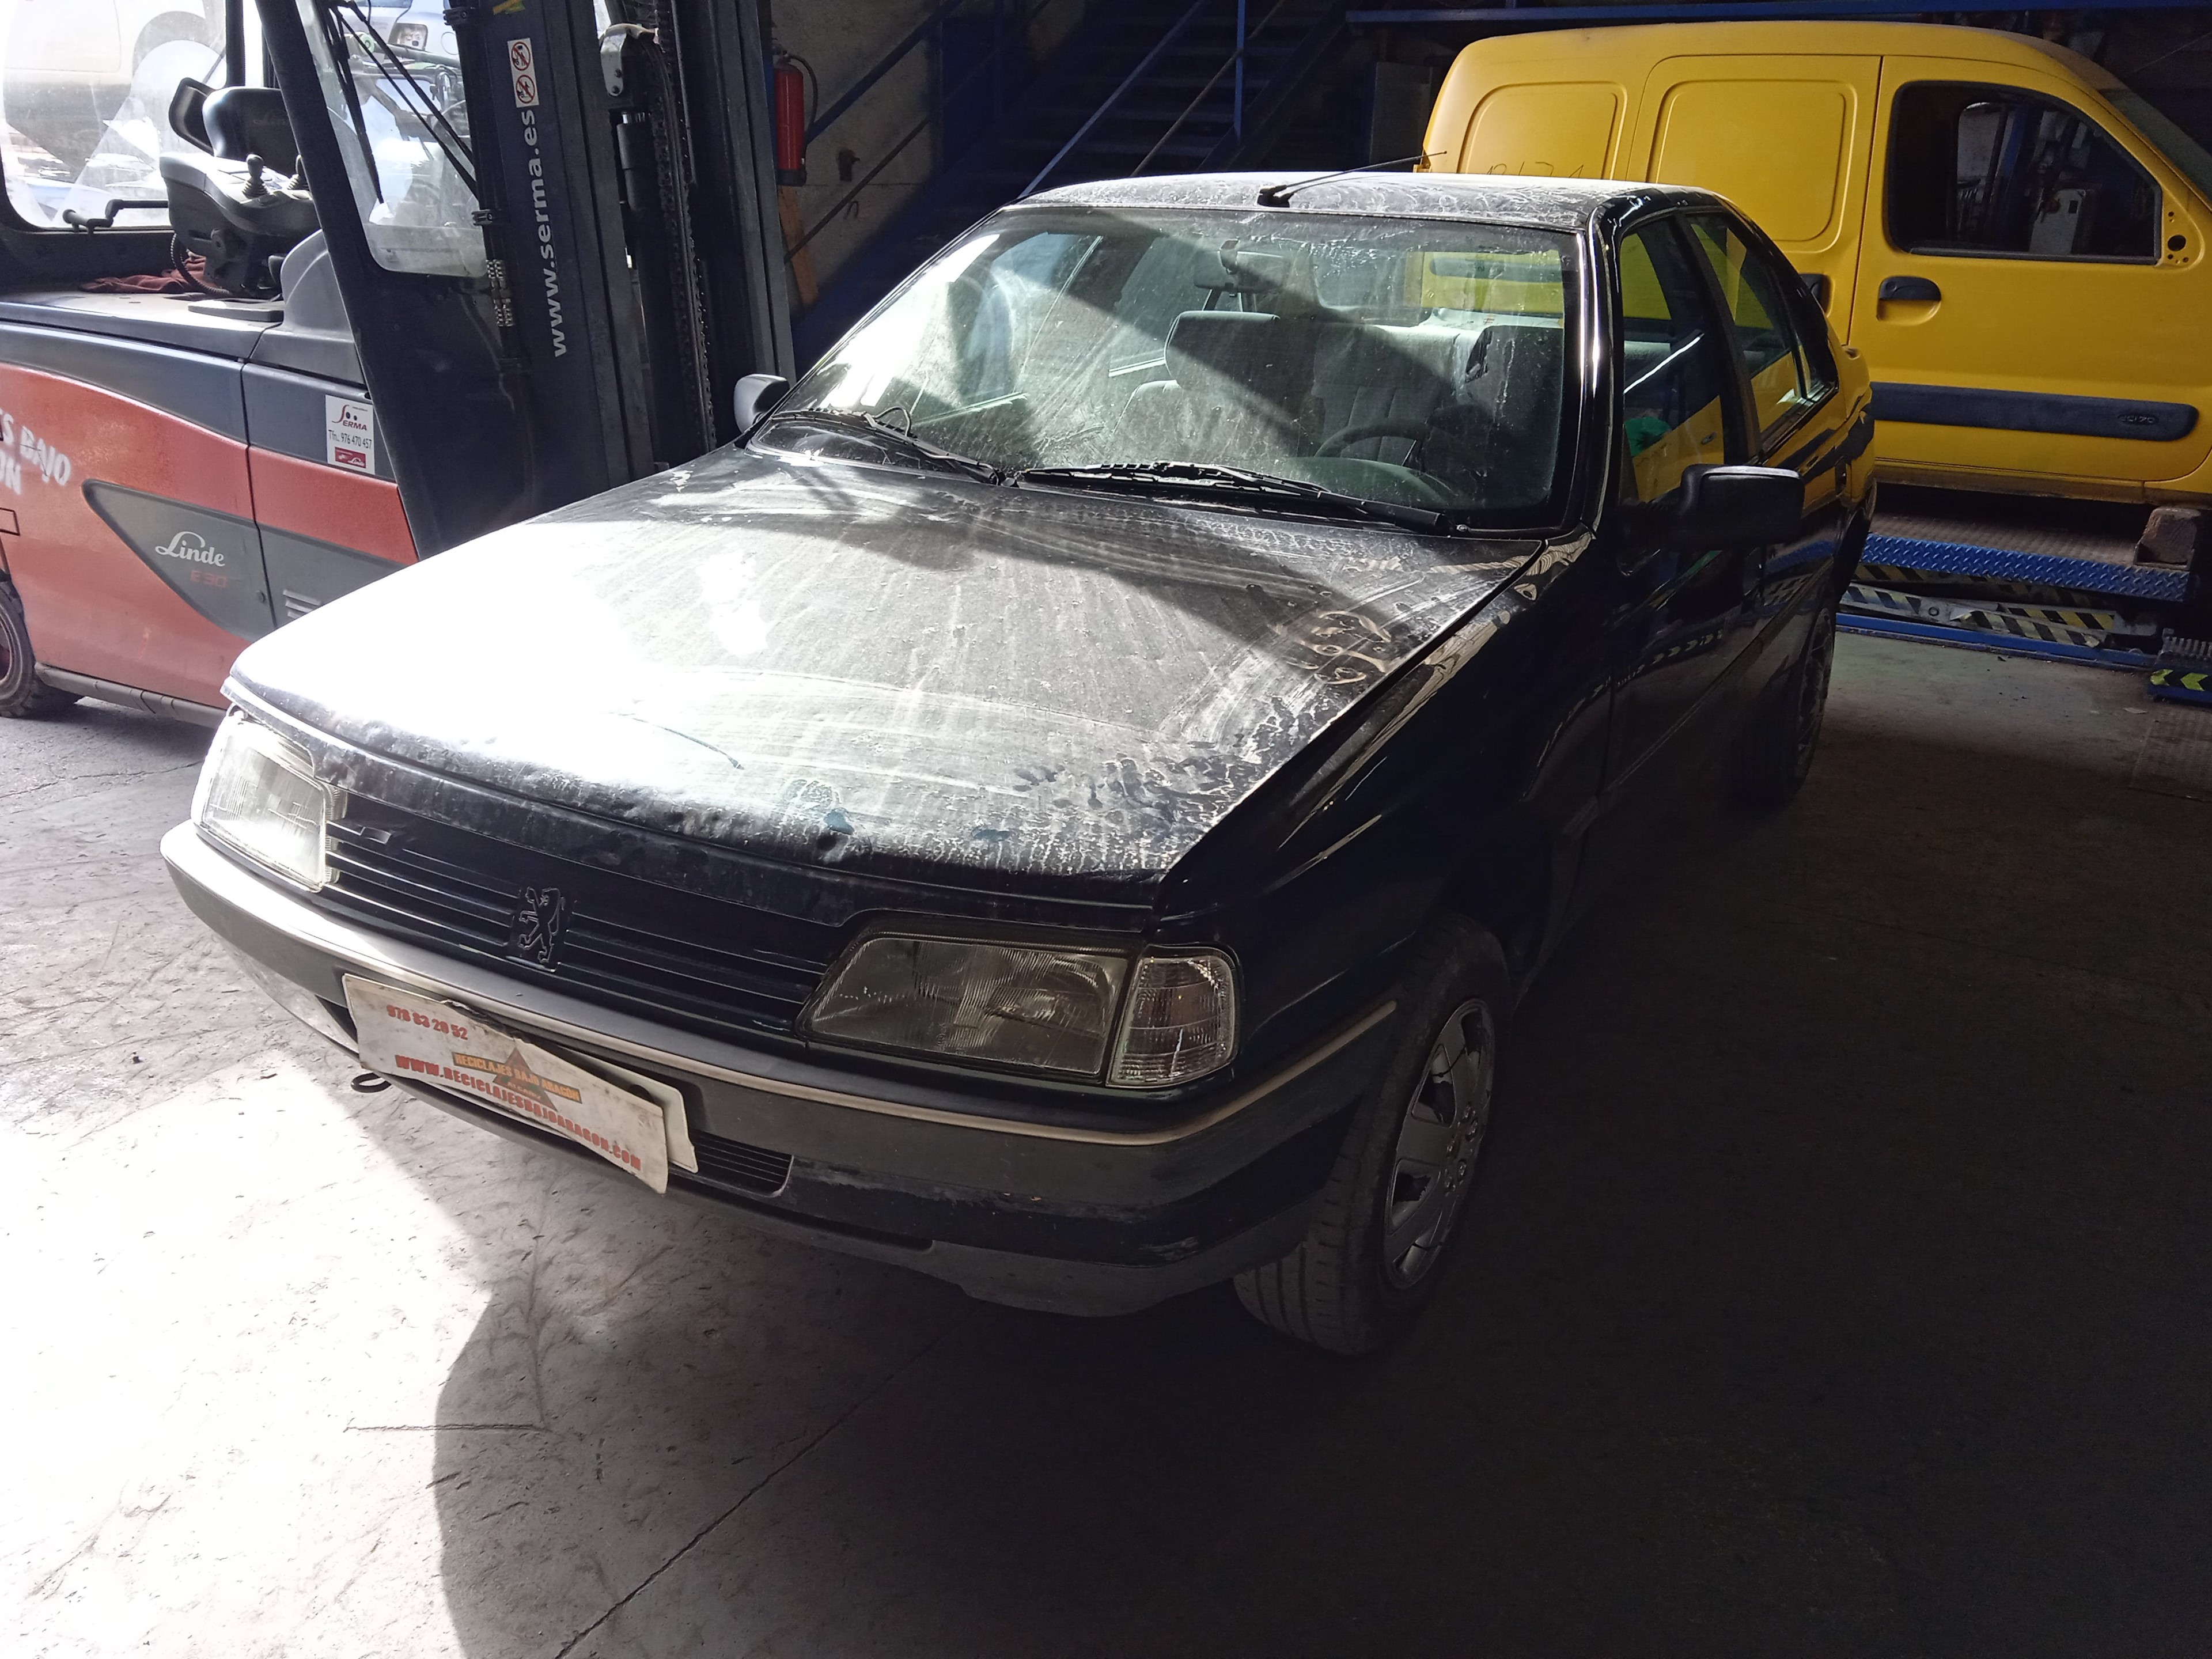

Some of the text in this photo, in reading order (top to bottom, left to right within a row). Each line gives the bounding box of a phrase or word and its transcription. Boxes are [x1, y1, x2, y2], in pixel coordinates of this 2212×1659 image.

[521, 109, 567, 358] www.serma.es
[0, 407, 71, 486] S BAJO
[340, 433, 351, 445] 976
[351, 435, 362, 447] 470
[362, 439, 372, 449] 457
[154, 531, 226, 567] Linde
[387, 1005, 411, 1022] 978
[431, 1018, 449, 1034] 20
[450, 1024, 468, 1040] 52
[455, 1054, 513, 1077] RECICLAJES
[514, 1068, 539, 1086] BAJO
